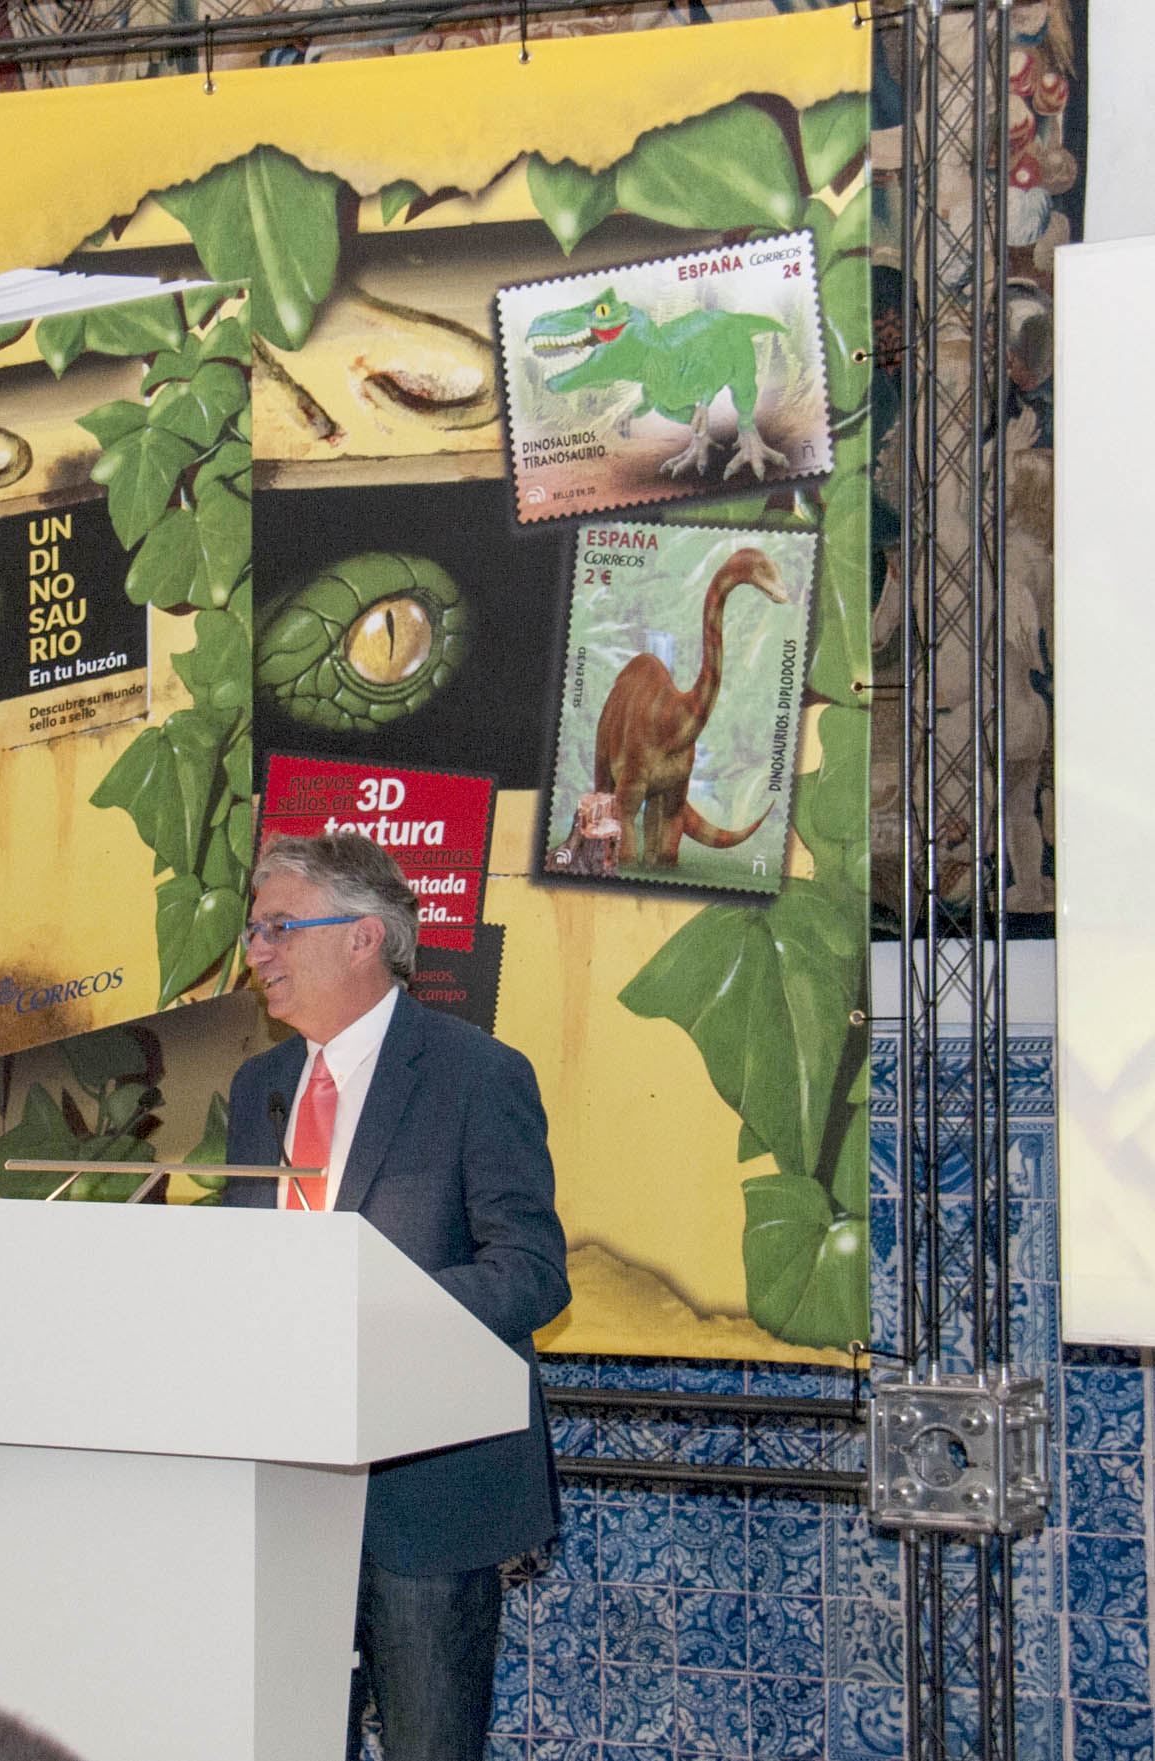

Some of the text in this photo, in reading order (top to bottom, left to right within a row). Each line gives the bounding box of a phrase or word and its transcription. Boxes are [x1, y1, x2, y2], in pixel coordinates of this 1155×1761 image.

[678, 246, 802, 281] ESPAÑA CORREOS
[783, 262, 802, 279] 2€
[29, 514, 72, 546] UN
[587, 530, 658, 550] ESPAÑA
[30, 546, 59, 576] DI
[584, 550, 645, 568] CORREOS
[29, 572, 75, 605] NO
[584, 568, 612, 586] 2 €
[29, 598, 87, 634] SAU
[29, 630, 82, 664] RIO
[29, 652, 128, 687] En tu buzón
[573, 646, 586, 708] SELLO EN 3D
[30, 683, 144, 719] Descubre su mundo
[769, 639, 797, 792] DINOSAURIOS. DIPLODOCUS
[29, 706, 96, 732] sello a sello
[278, 778, 406, 812] sellos en 3D
[289, 775, 355, 792] nuevos
[408, 873, 467, 894] ntada
[15, 967, 124, 1014] CORREOS
